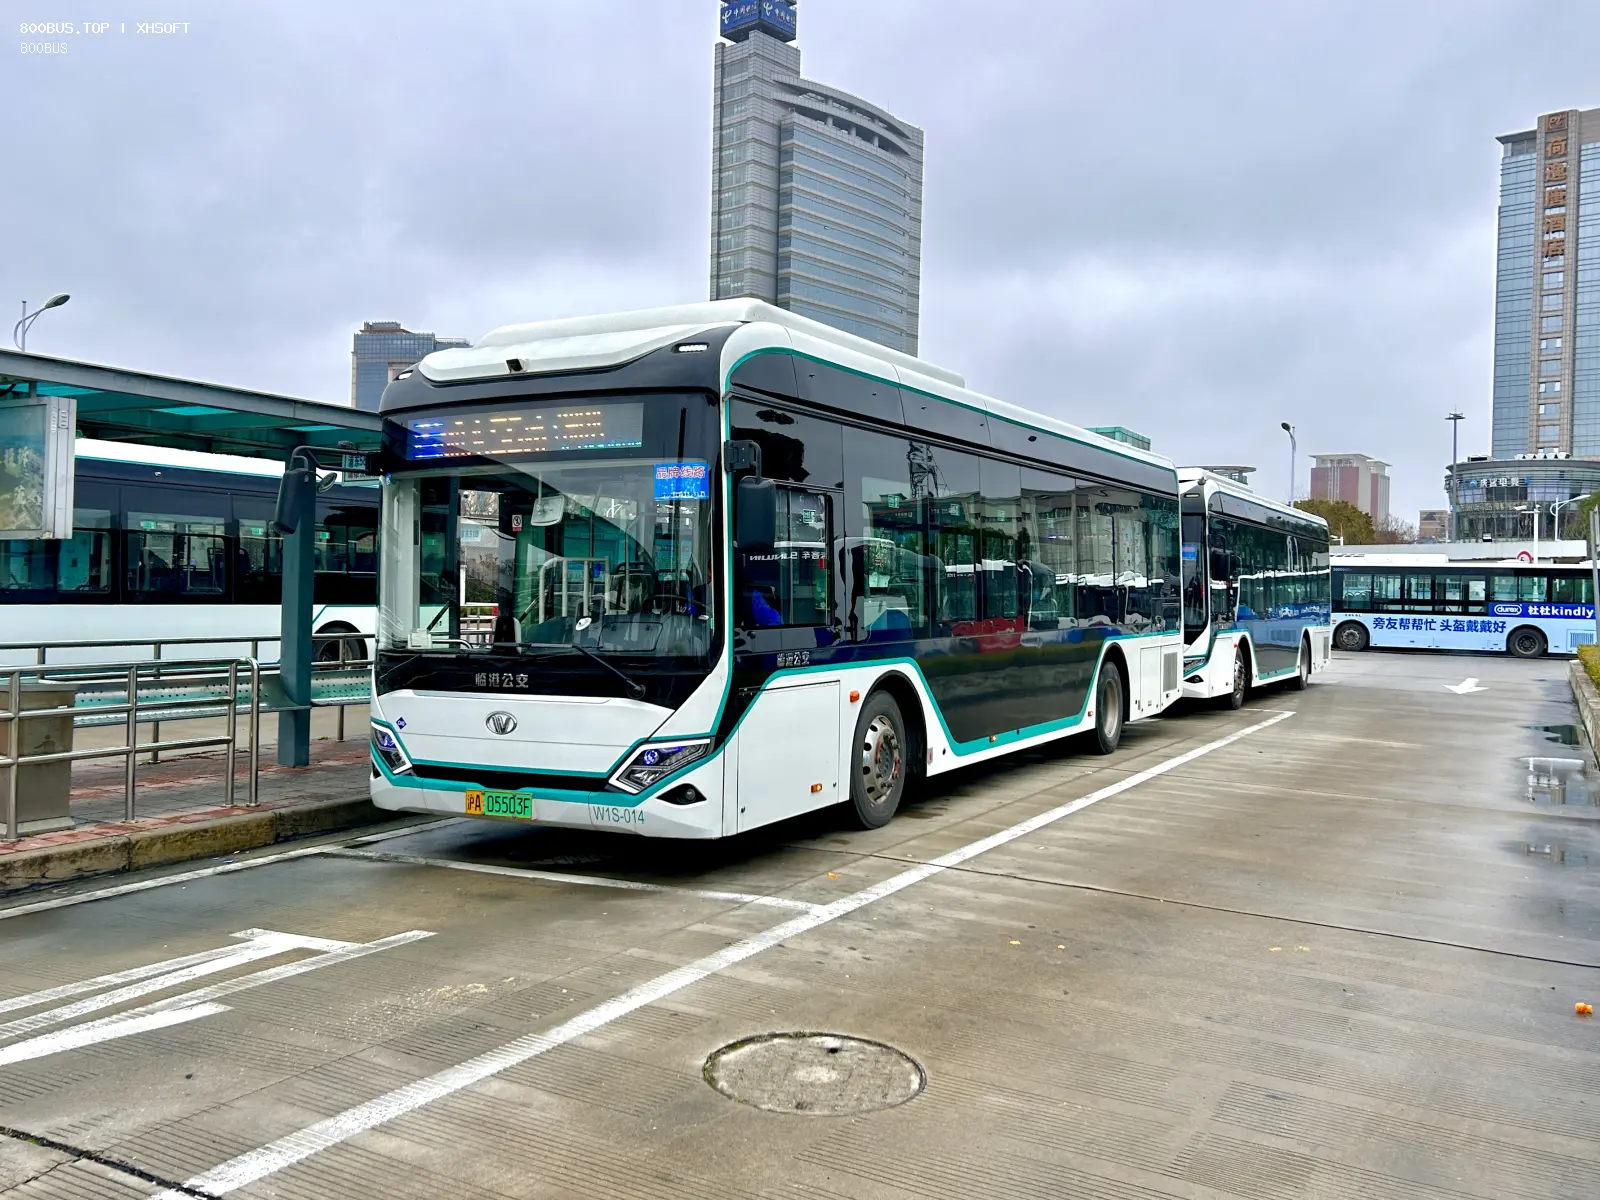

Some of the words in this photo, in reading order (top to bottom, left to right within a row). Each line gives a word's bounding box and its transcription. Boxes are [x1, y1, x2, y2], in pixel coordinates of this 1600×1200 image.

[656, 466, 706, 480] 品牌线路
[1496, 605, 1519, 613] durex
[1373, 617, 1437, 631] 旁友帮帮忙
[1440, 619, 1507, 633] 头盔戴戴好
[475, 672, 529, 688] 临港公交
[487, 795, 530, 815] 05503F
[592, 806, 645, 824] W1S-014
